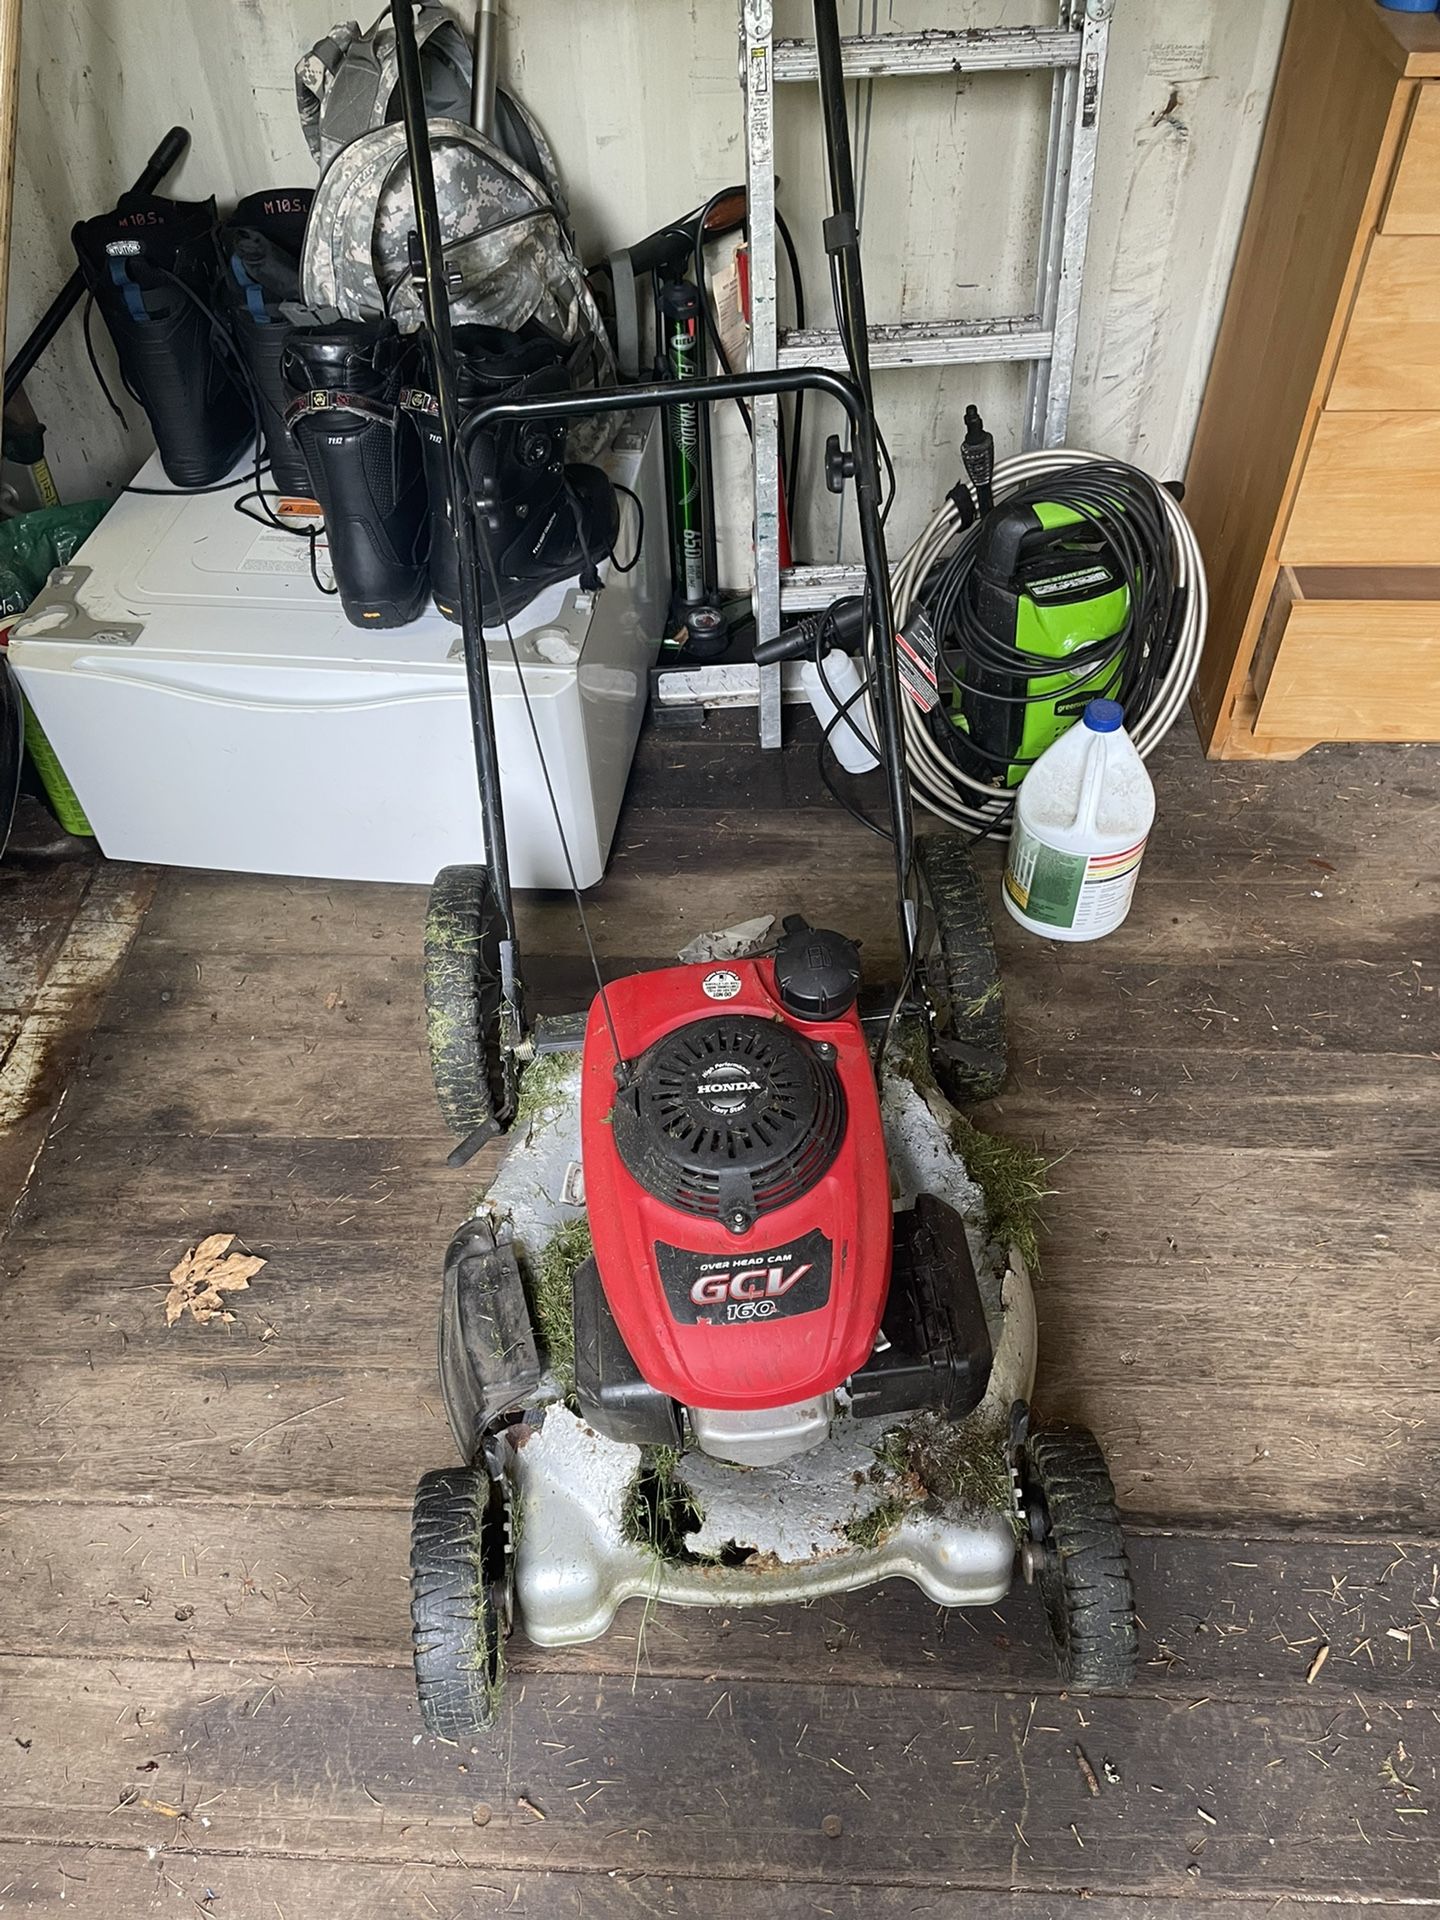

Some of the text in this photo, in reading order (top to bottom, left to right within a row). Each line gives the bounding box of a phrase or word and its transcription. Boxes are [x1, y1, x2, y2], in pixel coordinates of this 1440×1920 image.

[683, 529, 702, 558] 650
[702, 1062, 751, 1079] High Performance
[697, 1081, 761, 1094] HONDA
[711, 1103, 746, 1115] Easy Start
[700, 1254, 792, 1271] OVER HEAD CAM
[690, 1263, 813, 1305] GCV
[726, 1300, 777, 1320] 160
